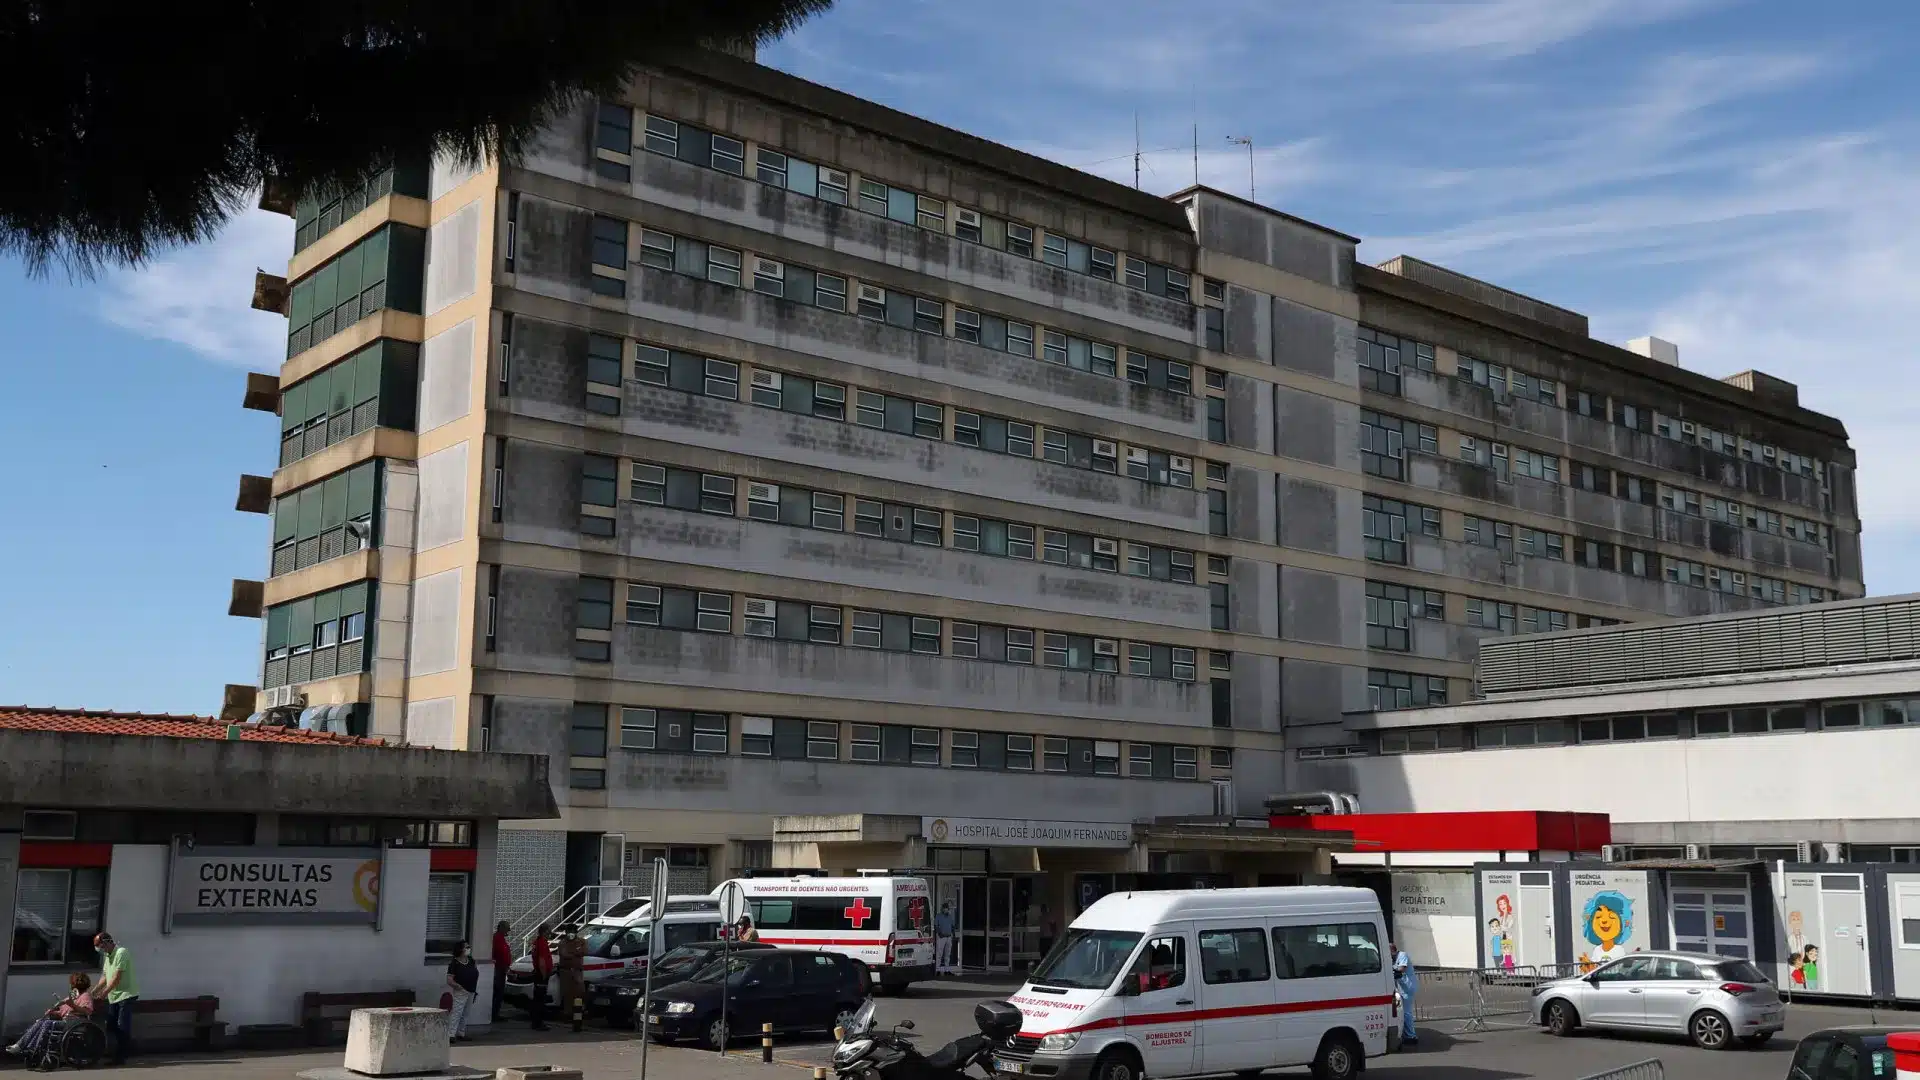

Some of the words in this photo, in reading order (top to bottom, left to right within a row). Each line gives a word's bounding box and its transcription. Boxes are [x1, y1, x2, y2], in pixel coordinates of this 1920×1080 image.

[955, 825, 1002, 838] HOSPITAL
[1005, 825, 1028, 838] JOSÉ
[1030, 826, 1071, 840] JOAQUIM
[1074, 828, 1128, 841] FERNANDES
[200, 863, 332, 883] CONSULTAS
[825, 885, 838, 893] NÃO
[1400, 884, 1430, 894] URGÊNCIA
[198, 889, 318, 907] EXTERNAS
[1400, 894, 1446, 906] PEDIÁTRICA
[1146, 1031, 1182, 1040] BOMBEIROS
[1151, 1038, 1186, 1046] ALJUSTREL
